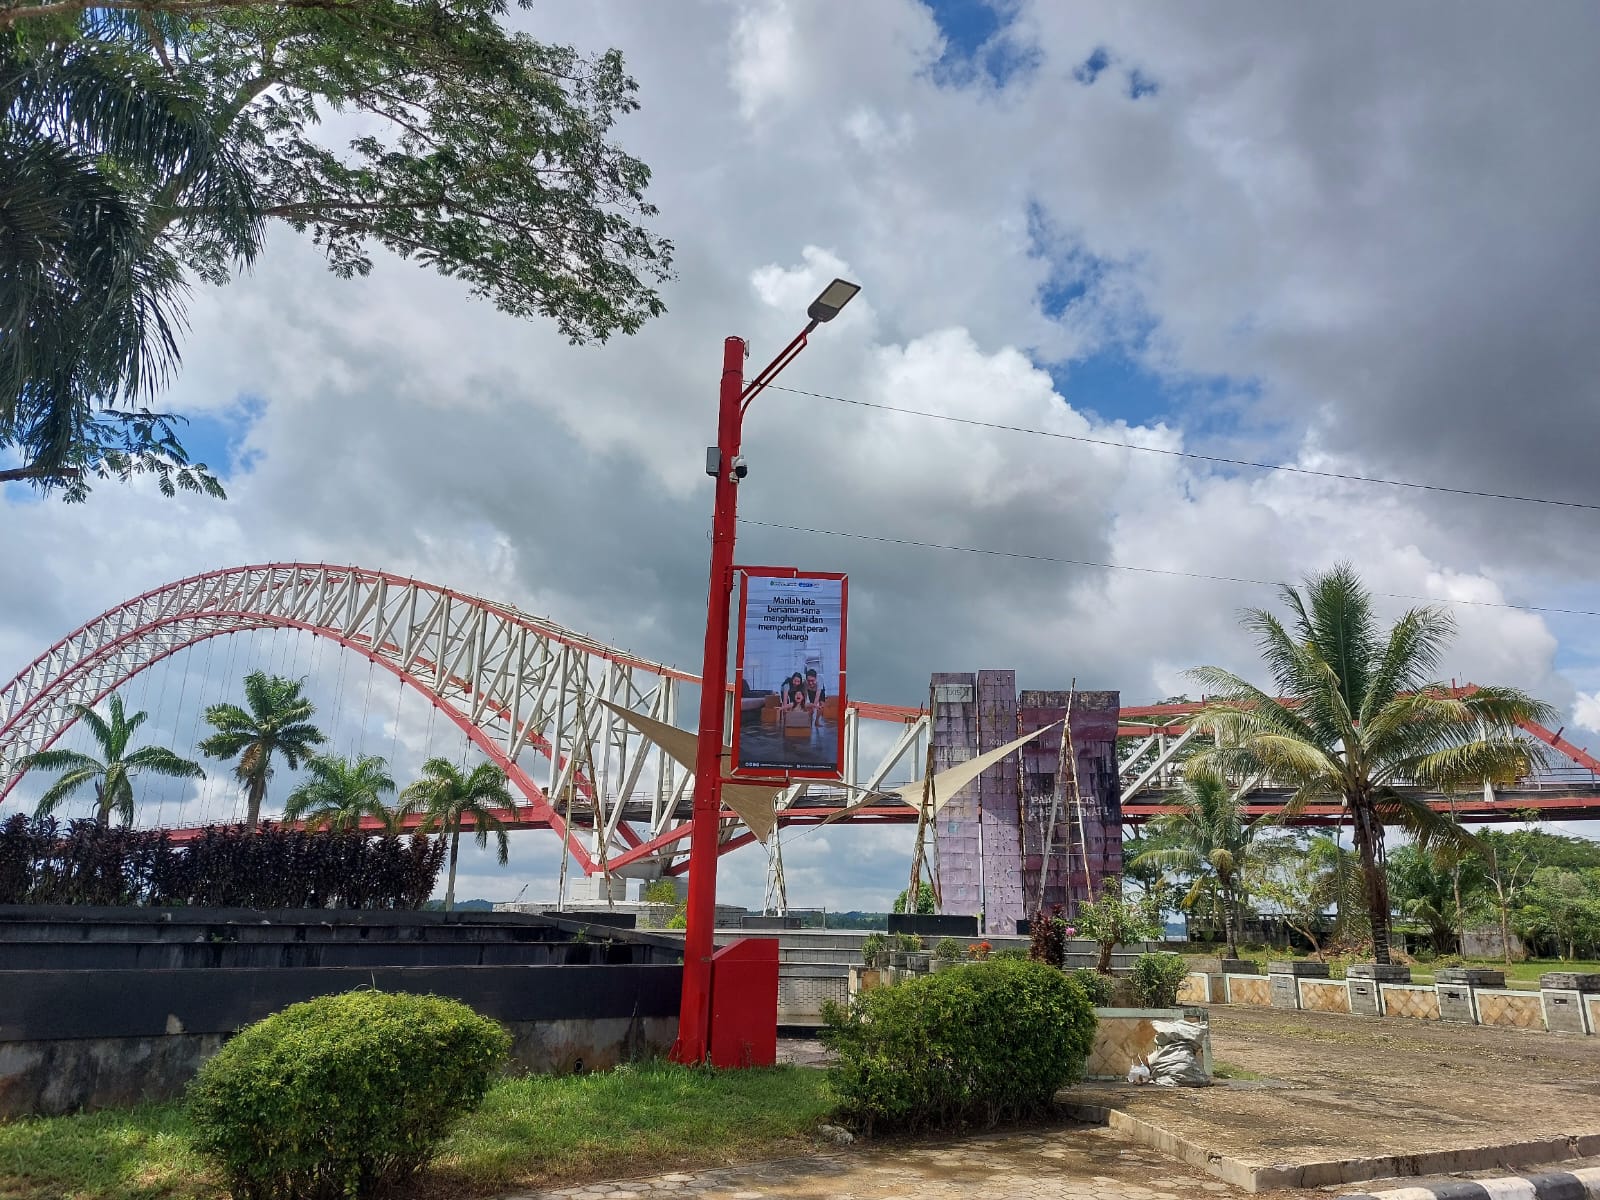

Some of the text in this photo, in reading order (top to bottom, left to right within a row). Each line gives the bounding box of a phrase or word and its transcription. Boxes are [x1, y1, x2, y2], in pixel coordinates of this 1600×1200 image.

[774, 597, 816, 606] Marilah kita
[763, 614, 824, 624] menghargai dan
[758, 624, 828, 633] memperkuat peran
[776, 631, 809, 642] keluarga
